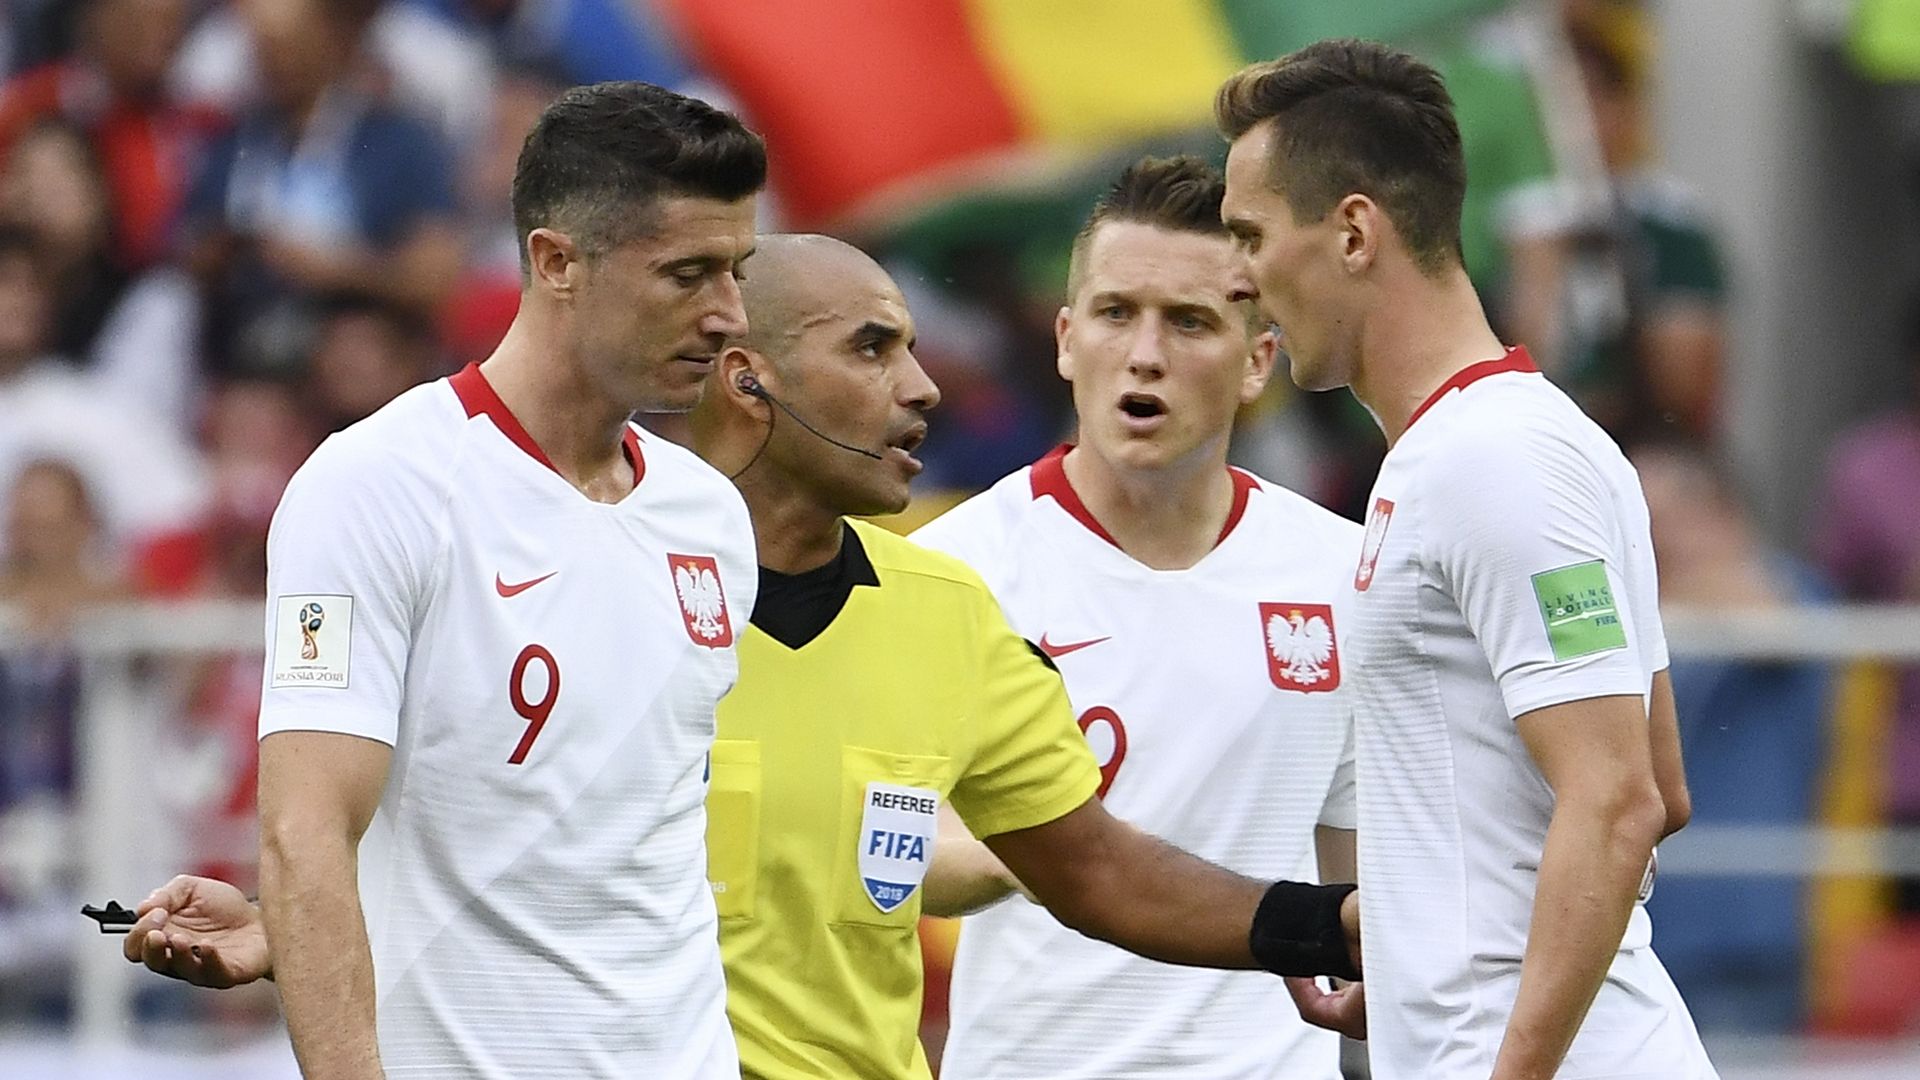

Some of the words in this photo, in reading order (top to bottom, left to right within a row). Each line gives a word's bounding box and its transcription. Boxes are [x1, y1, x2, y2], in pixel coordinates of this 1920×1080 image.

[1544, 587, 1609, 609] LIVING
[1595, 615, 1618, 627] FIFA
[276, 672, 314, 681] RUSSIA
[316, 672, 344, 682] 2018
[507, 643, 561, 766] 9
[871, 791, 935, 815] REFEREE
[868, 829, 924, 863] FIFA
[875, 885, 904, 900] 2018
